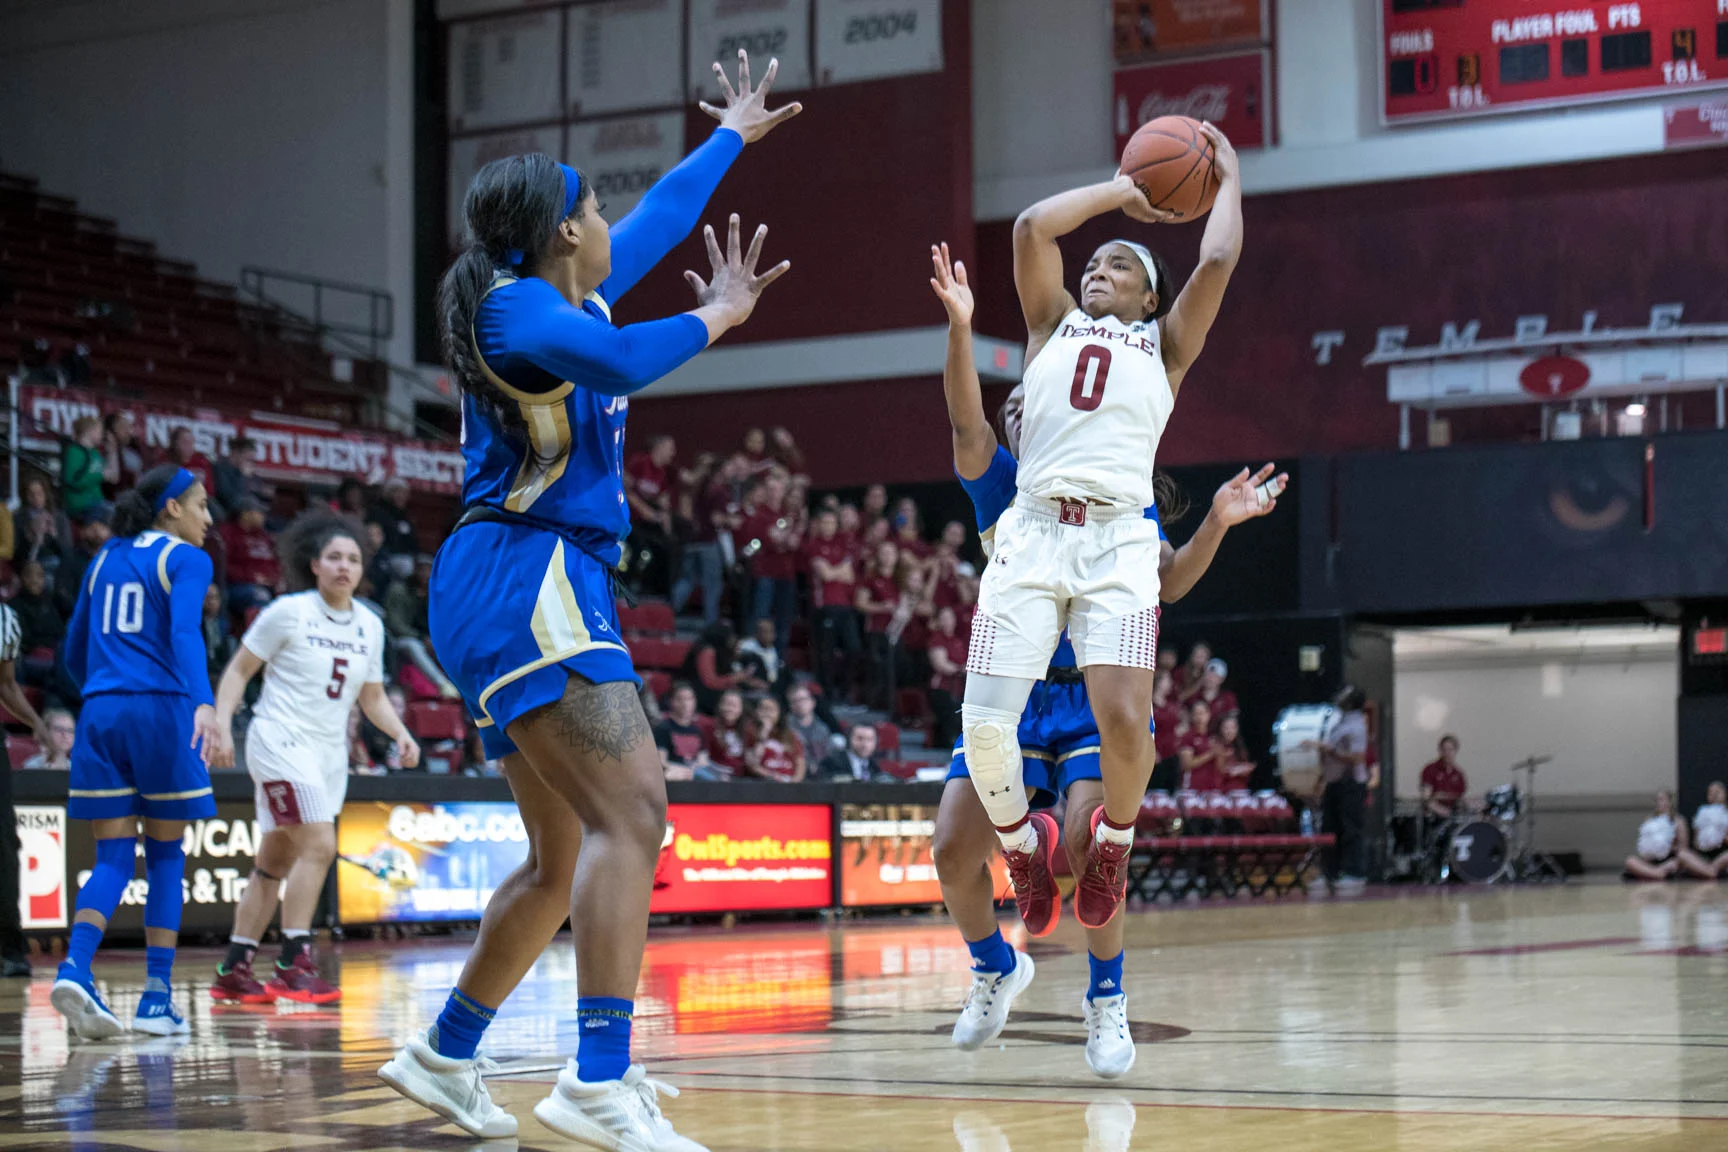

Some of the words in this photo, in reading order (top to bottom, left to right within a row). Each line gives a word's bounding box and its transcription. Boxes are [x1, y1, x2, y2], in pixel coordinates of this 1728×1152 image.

[844, 9, 918, 46] 2004
[1491, 13, 1554, 44] PLAYER
[1555, 8, 1598, 36] FOUL
[1608, 2, 1641, 30] PTS
[716, 26, 788, 61] 2002
[1061, 324, 1155, 357] TEMPLE
[1069, 343, 1112, 412] 0
[102, 581, 145, 635] 10
[307, 635, 369, 656] TEMPLE
[326, 656, 350, 700] 5
[674, 833, 832, 867] OwlSports.com
